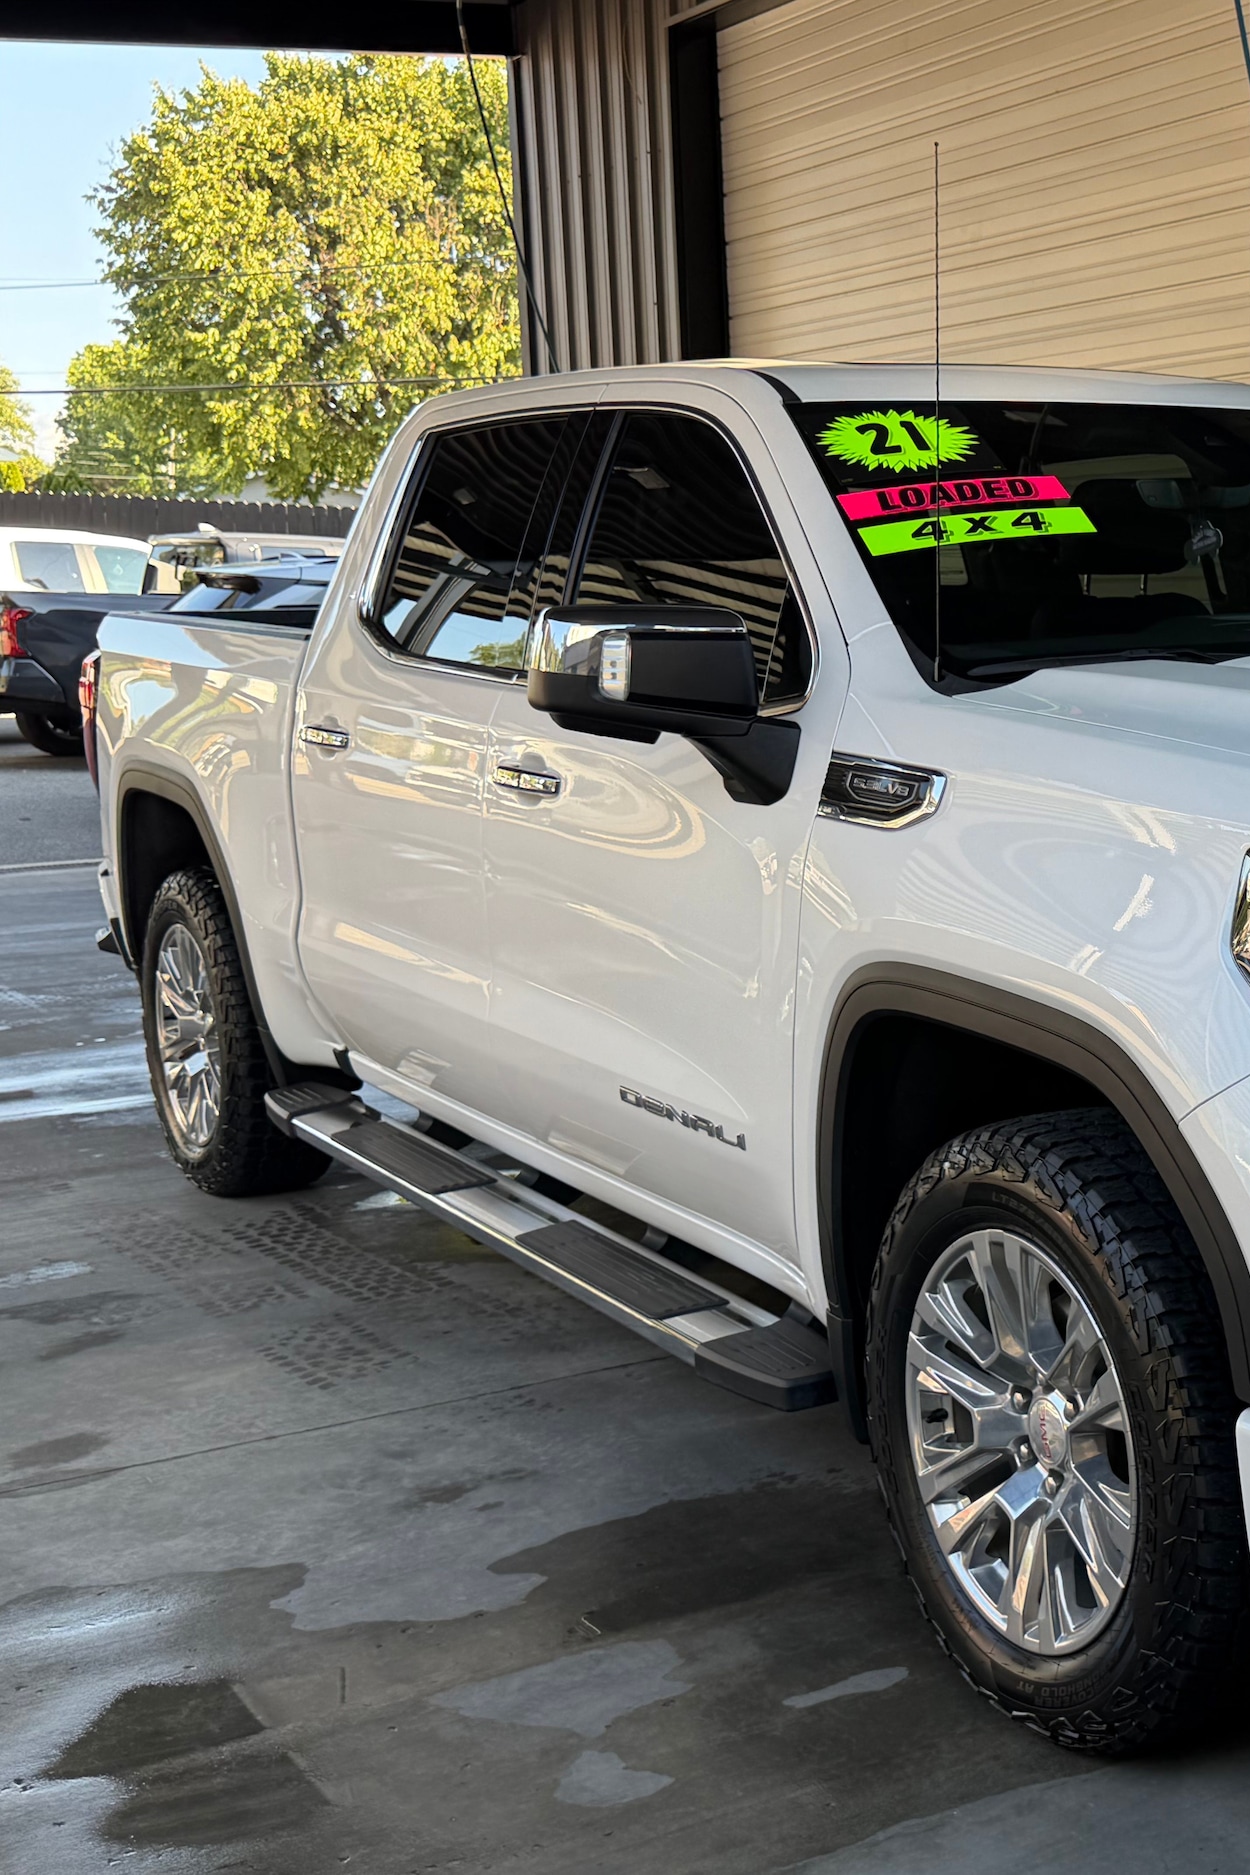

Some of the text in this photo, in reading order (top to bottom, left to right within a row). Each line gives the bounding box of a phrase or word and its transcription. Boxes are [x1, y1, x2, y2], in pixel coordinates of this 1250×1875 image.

[856, 421, 934, 455] 21
[877, 479, 1037, 513] LOADED
[619, 1085, 747, 1151] DENALI
[1039, 1405, 1052, 1459] GMC
[1016, 1680, 1035, 1694] AT
